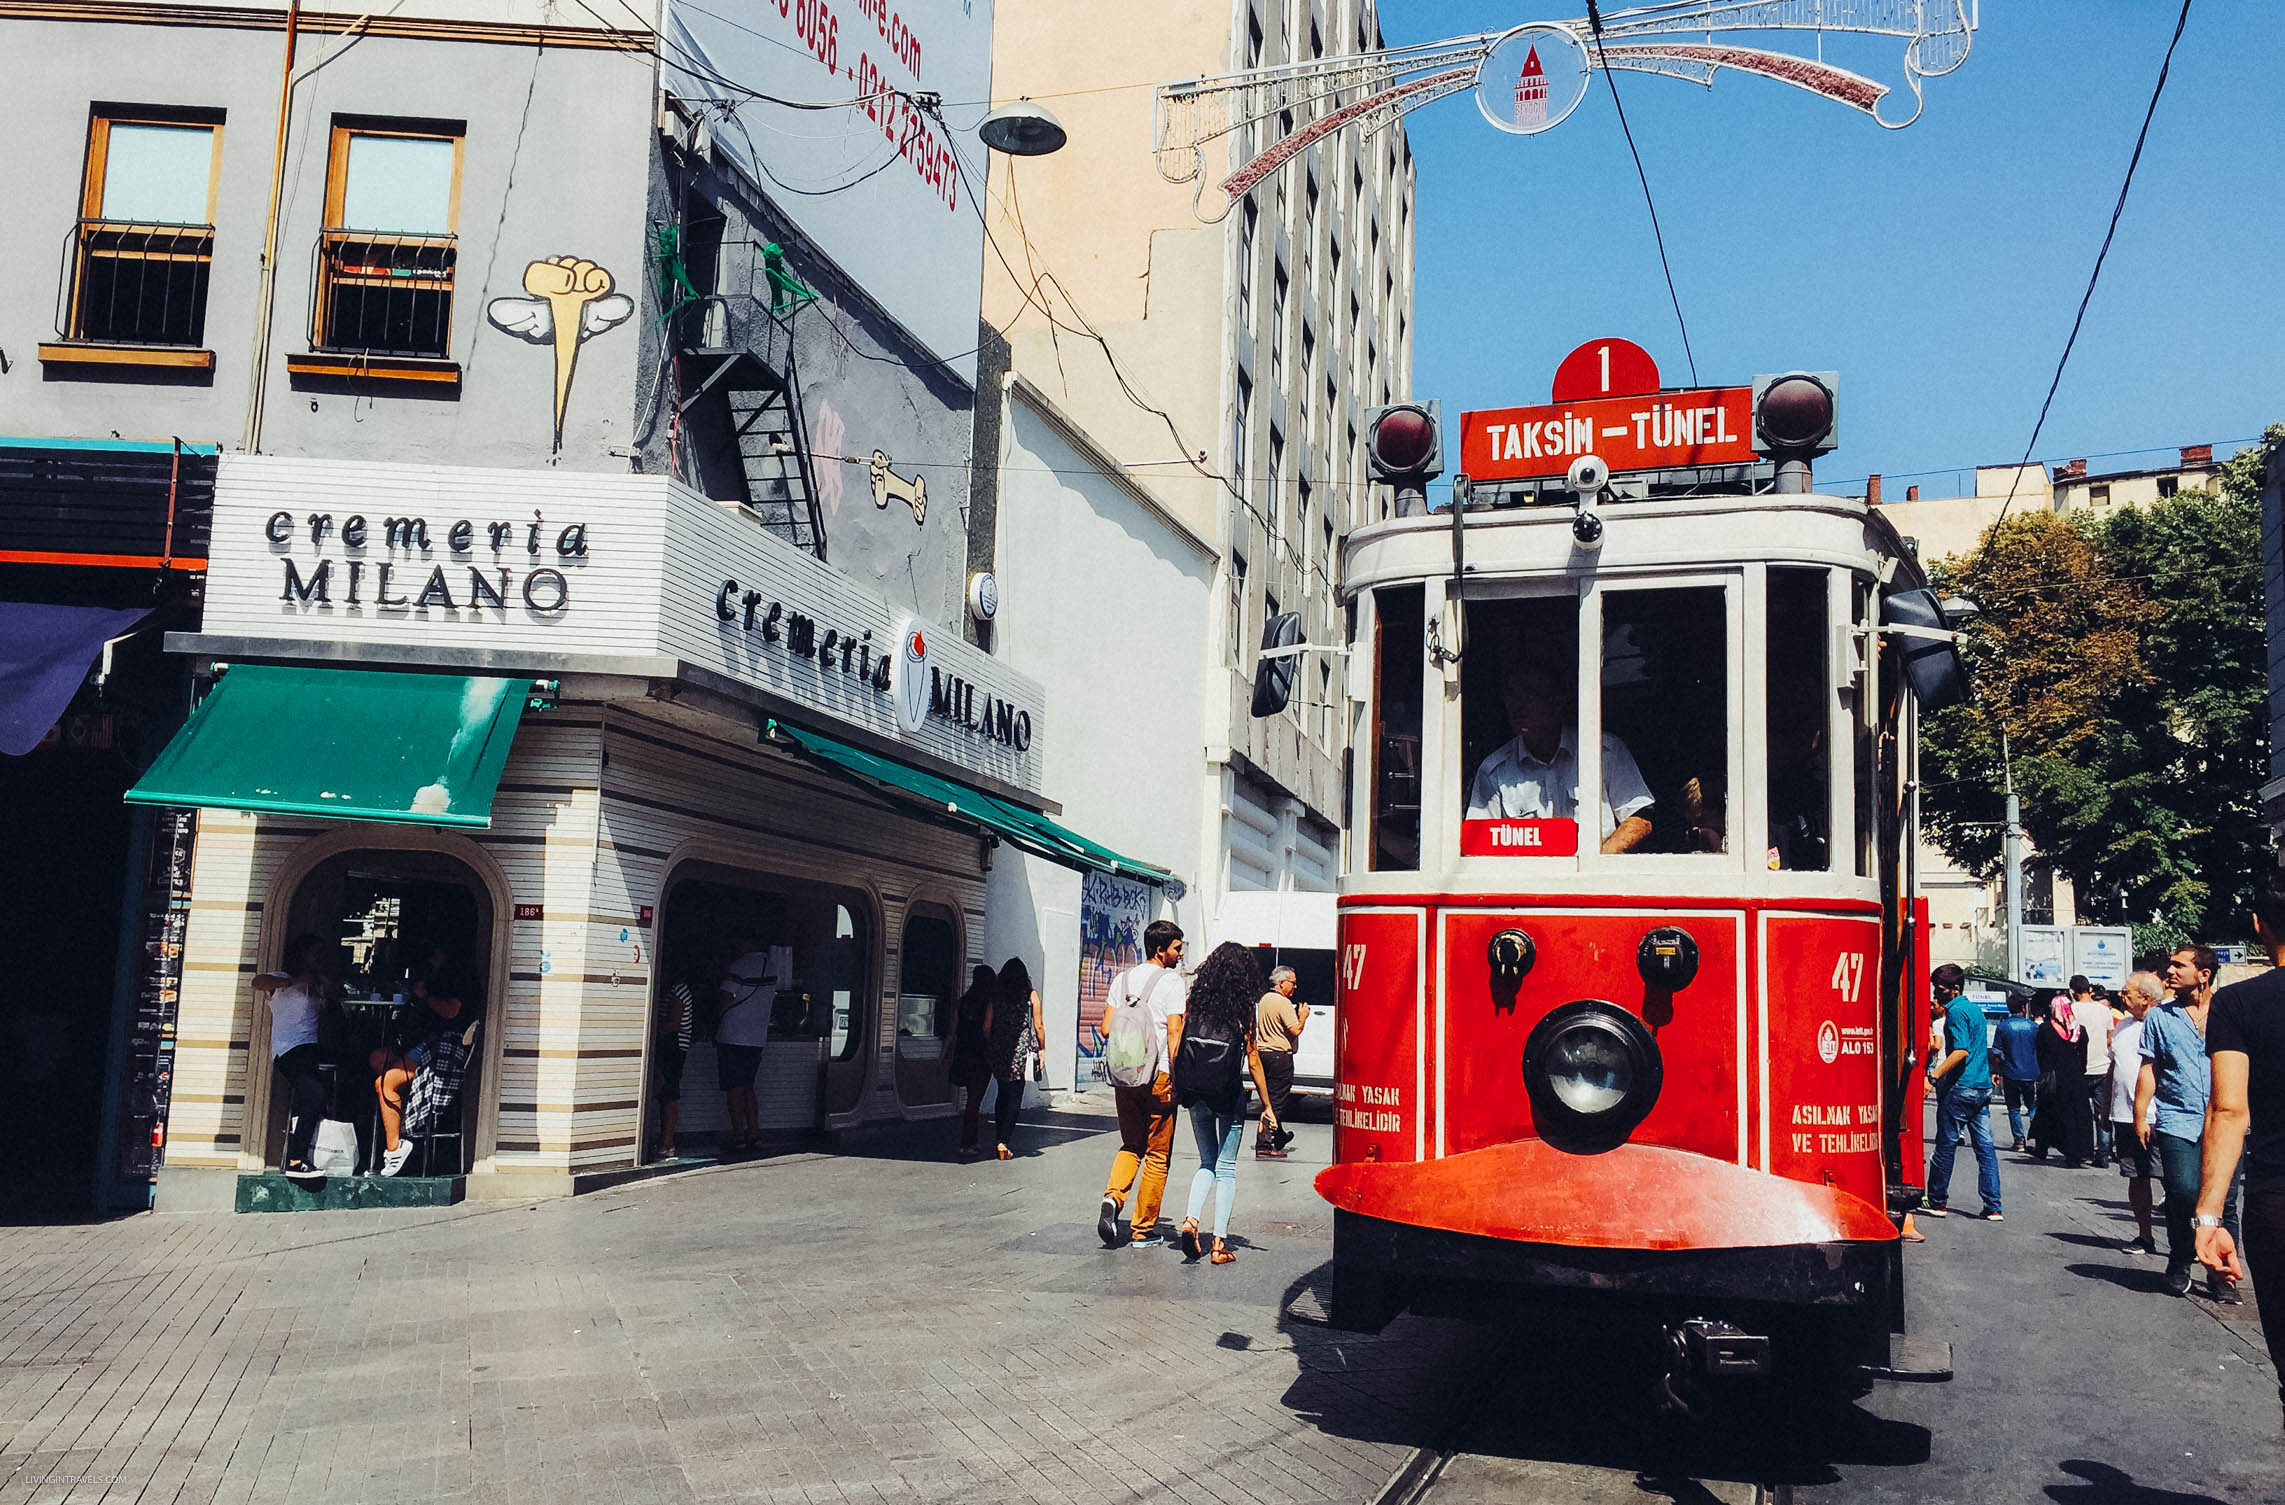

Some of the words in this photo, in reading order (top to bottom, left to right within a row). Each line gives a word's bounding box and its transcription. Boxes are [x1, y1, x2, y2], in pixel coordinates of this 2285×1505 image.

[1597, 346, 1610, 392] 1
[1631, 403, 1737, 449] TÜNEL
[265, 508, 589, 557] cremeria
[279, 557, 569, 611] MILANO
[716, 579, 892, 692] cremeria
[929, 666, 1032, 752] MILANO
[1489, 824, 1542, 846] TÜNEL
[1343, 944, 1367, 991] 47
[1831, 952, 1864, 1003] 47
[1841, 1041, 1861, 1055] ALO
[1361, 1085, 1400, 1106] YASAK
[1791, 1104, 1851, 1126] ASILMAK
[1791, 1133, 1813, 1153] VE
